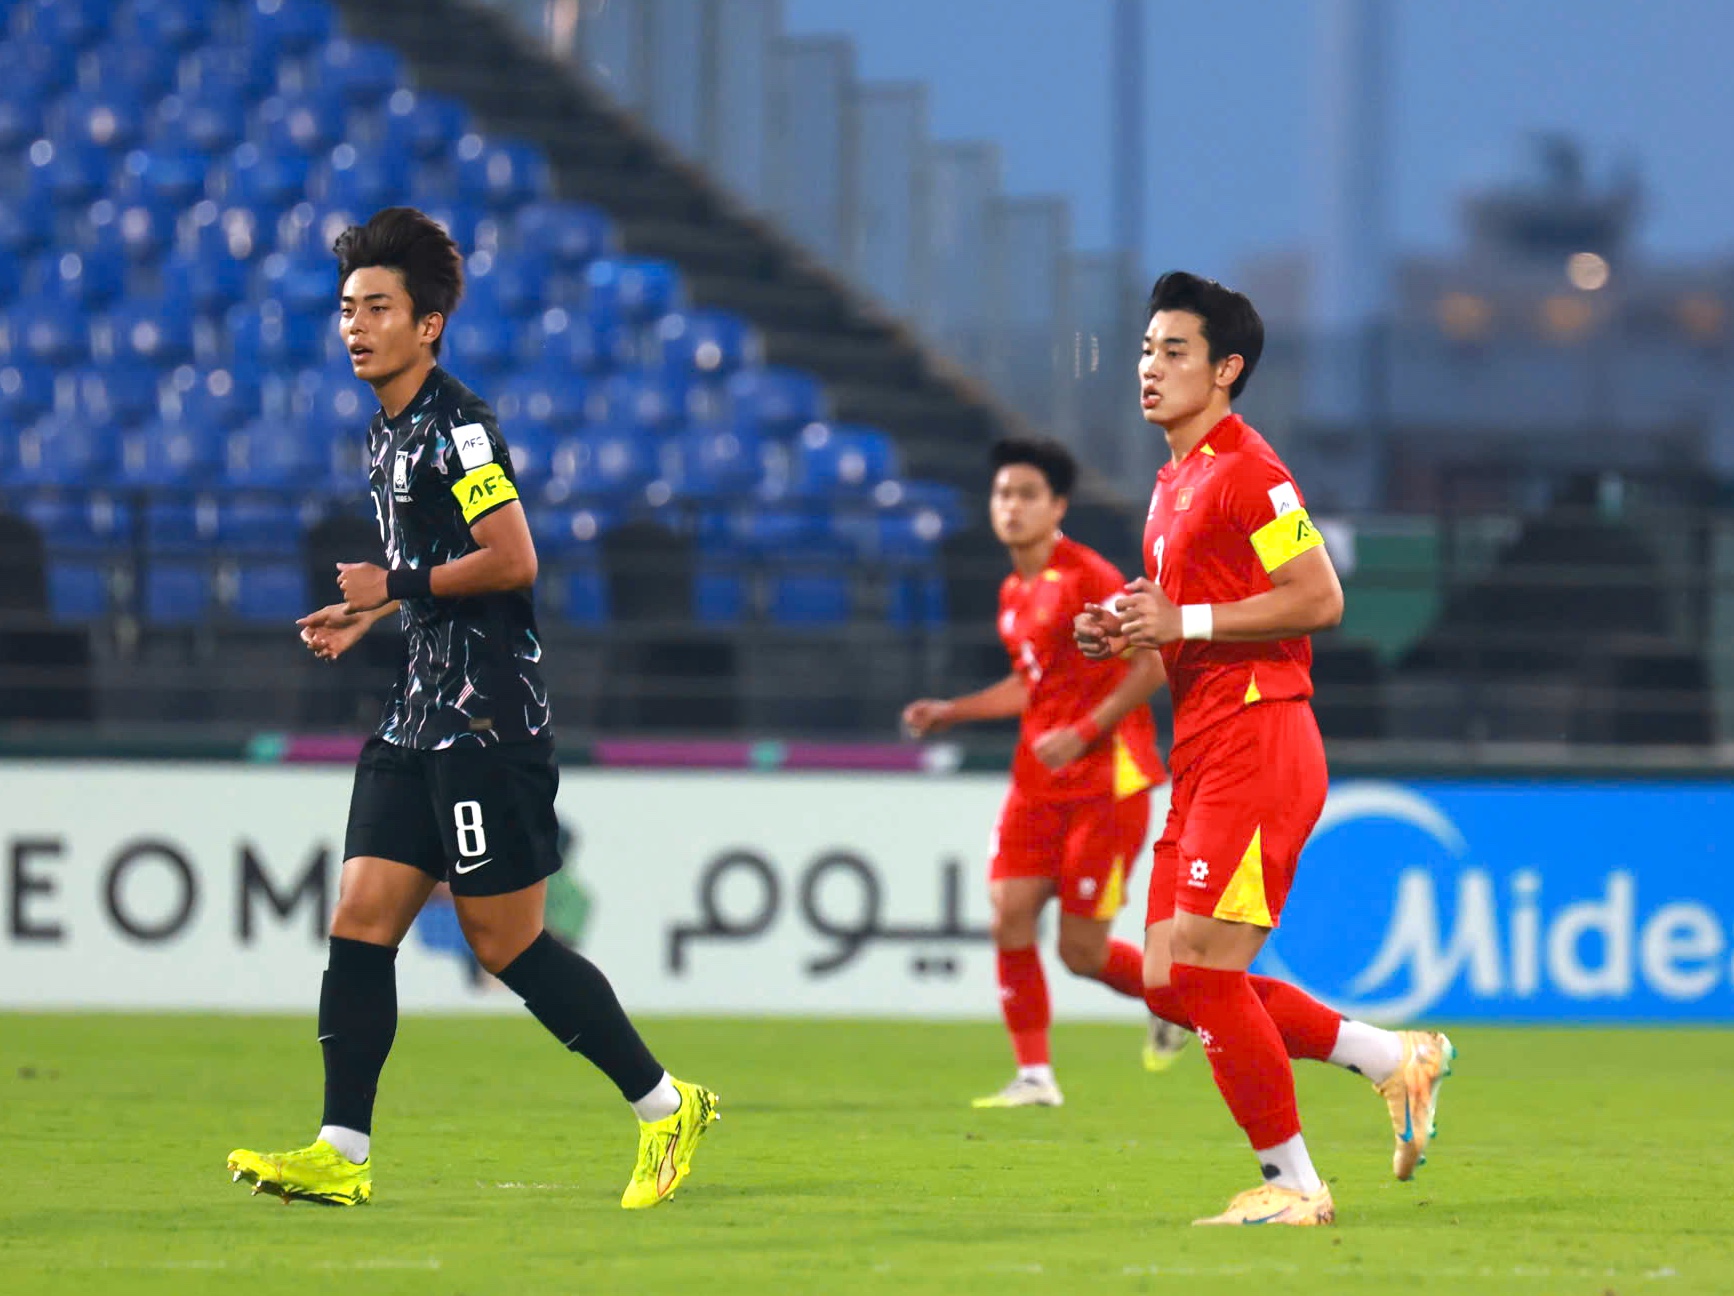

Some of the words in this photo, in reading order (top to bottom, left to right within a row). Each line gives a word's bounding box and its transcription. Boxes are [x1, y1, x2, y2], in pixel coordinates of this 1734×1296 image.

[462, 436, 485, 452] AFC
[454, 801, 487, 857] 8
[10, 837, 334, 943] EOM
[667, 848, 1044, 977] يوم
[1350, 866, 1734, 998] Mide
